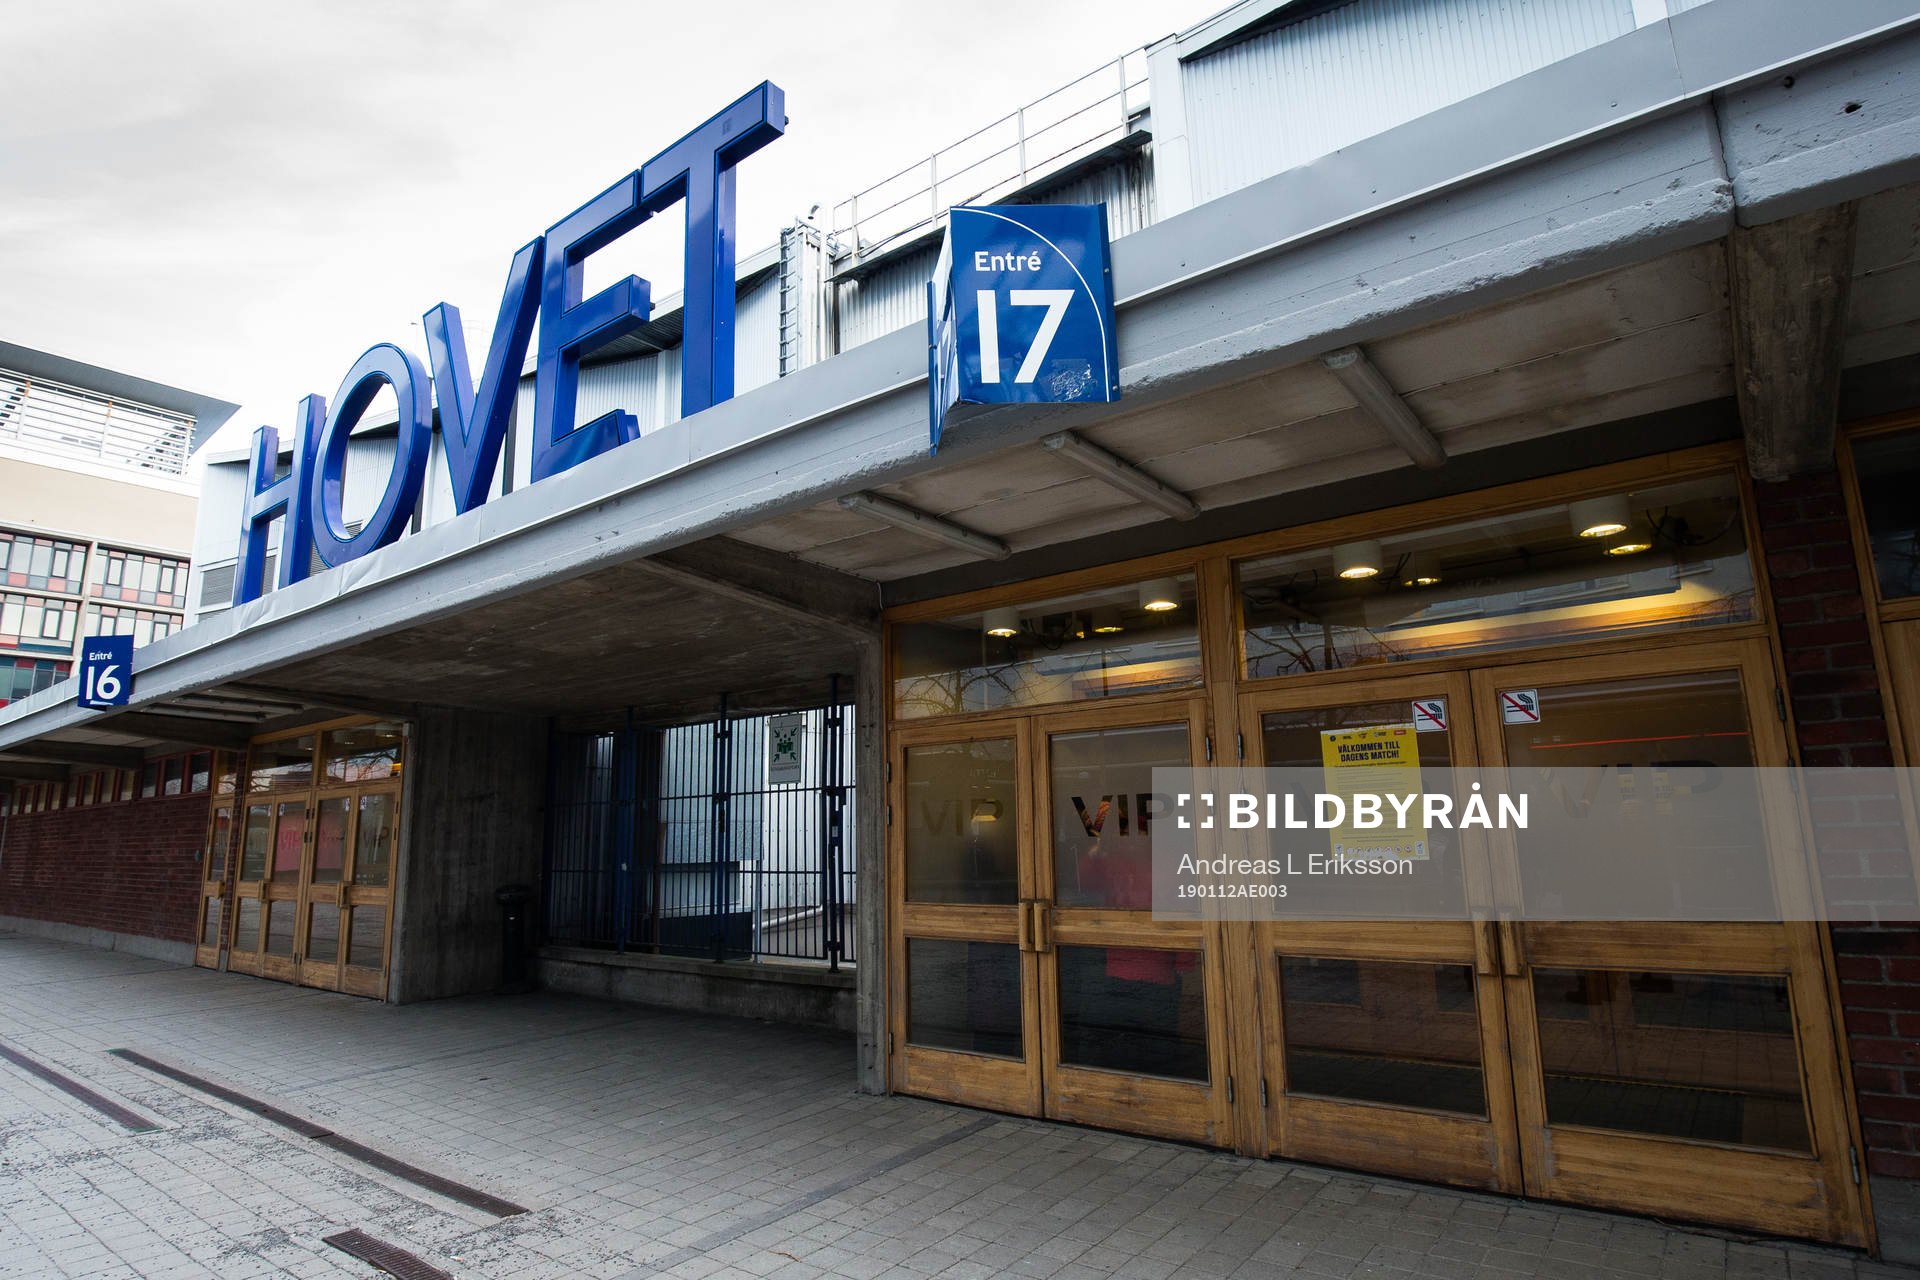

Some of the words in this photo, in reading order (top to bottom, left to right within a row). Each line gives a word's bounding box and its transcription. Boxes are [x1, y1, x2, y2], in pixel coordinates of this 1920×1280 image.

[974, 250, 1042, 272] Entré
[233, 79, 785, 608] HOVET
[976, 289, 1075, 384] 17
[88, 650, 113, 661] Entré
[85, 664, 121, 700] 16
[1338, 741, 1383, 754] VÄLKOMMEN
[1384, 740, 1400, 750] TILL
[1340, 750, 1370, 762] DAGENS
[1371, 748, 1400, 760] MATCH!
[1070, 792, 1176, 837] VIP
